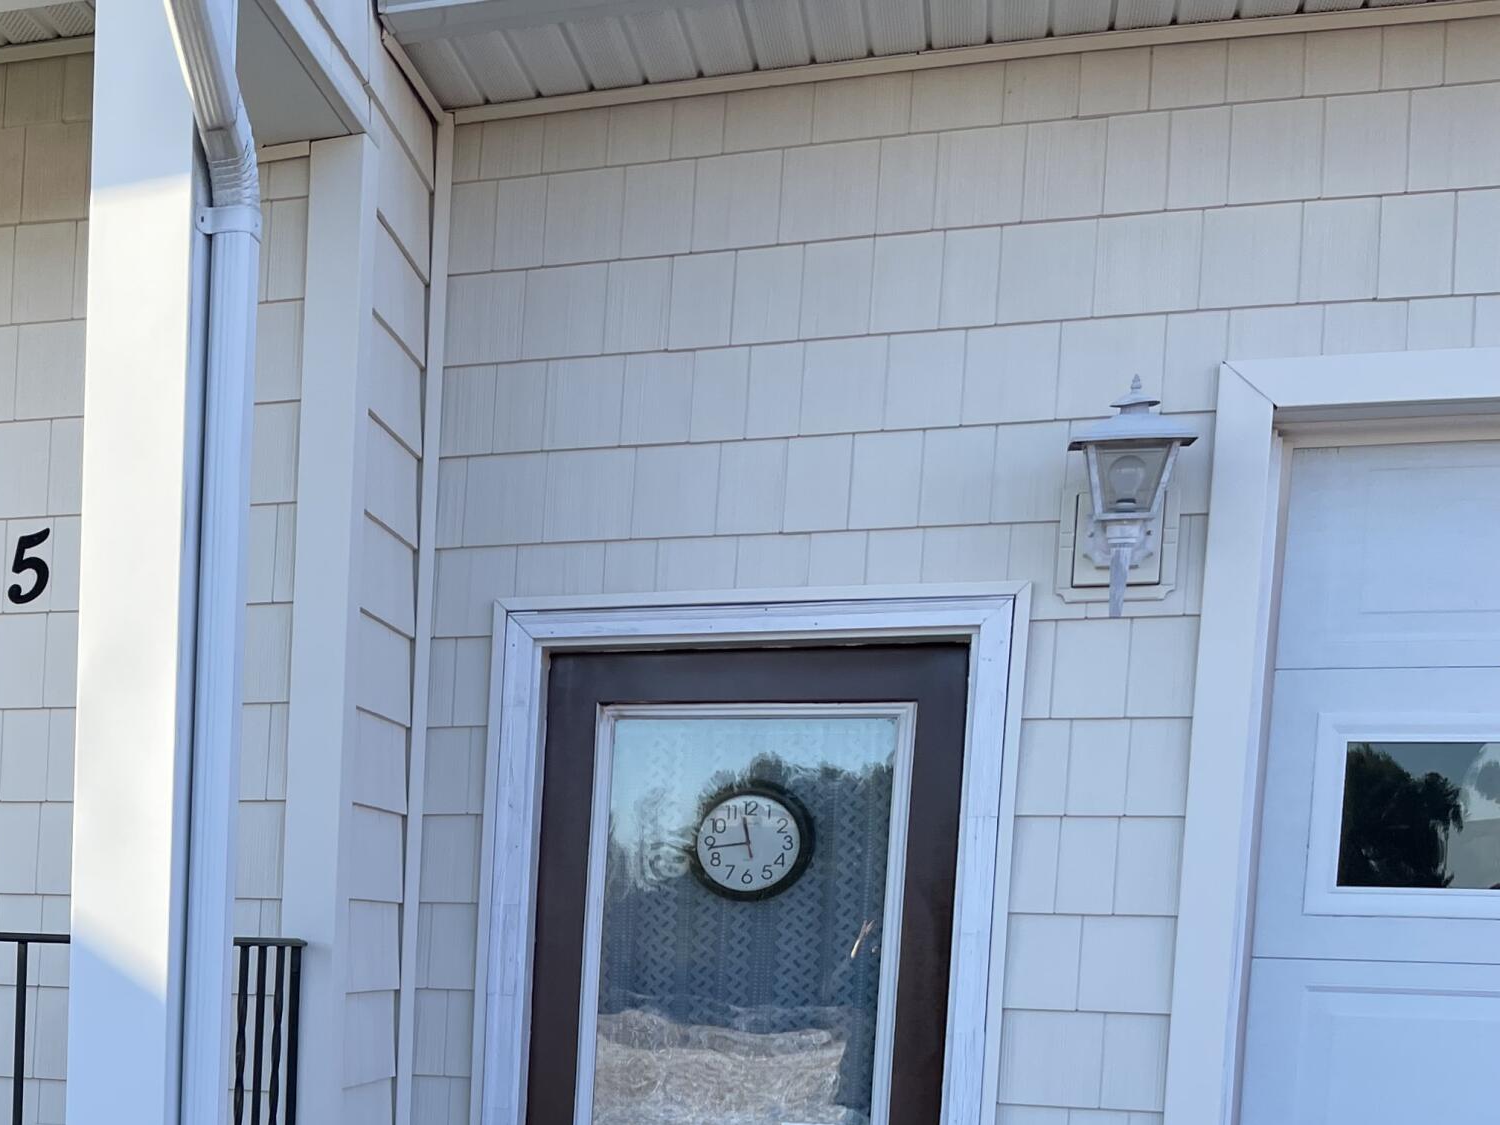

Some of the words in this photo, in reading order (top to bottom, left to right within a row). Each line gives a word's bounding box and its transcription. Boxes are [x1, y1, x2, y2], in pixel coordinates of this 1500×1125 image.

[7, 527, 51, 605] 5
[725, 805, 738, 820] 11
[743, 800, 759, 816] 12
[766, 804, 771, 819] 1
[709, 818, 726, 834] 10
[776, 818, 789, 834] 2
[704, 835, 716, 851] 9
[782, 835, 794, 851] 3
[710, 851, 721, 867] 8
[773, 852, 785, 867] 4
[725, 865, 736, 880] 7
[741, 869, 753, 885] 6
[761, 864, 773, 880] 5
